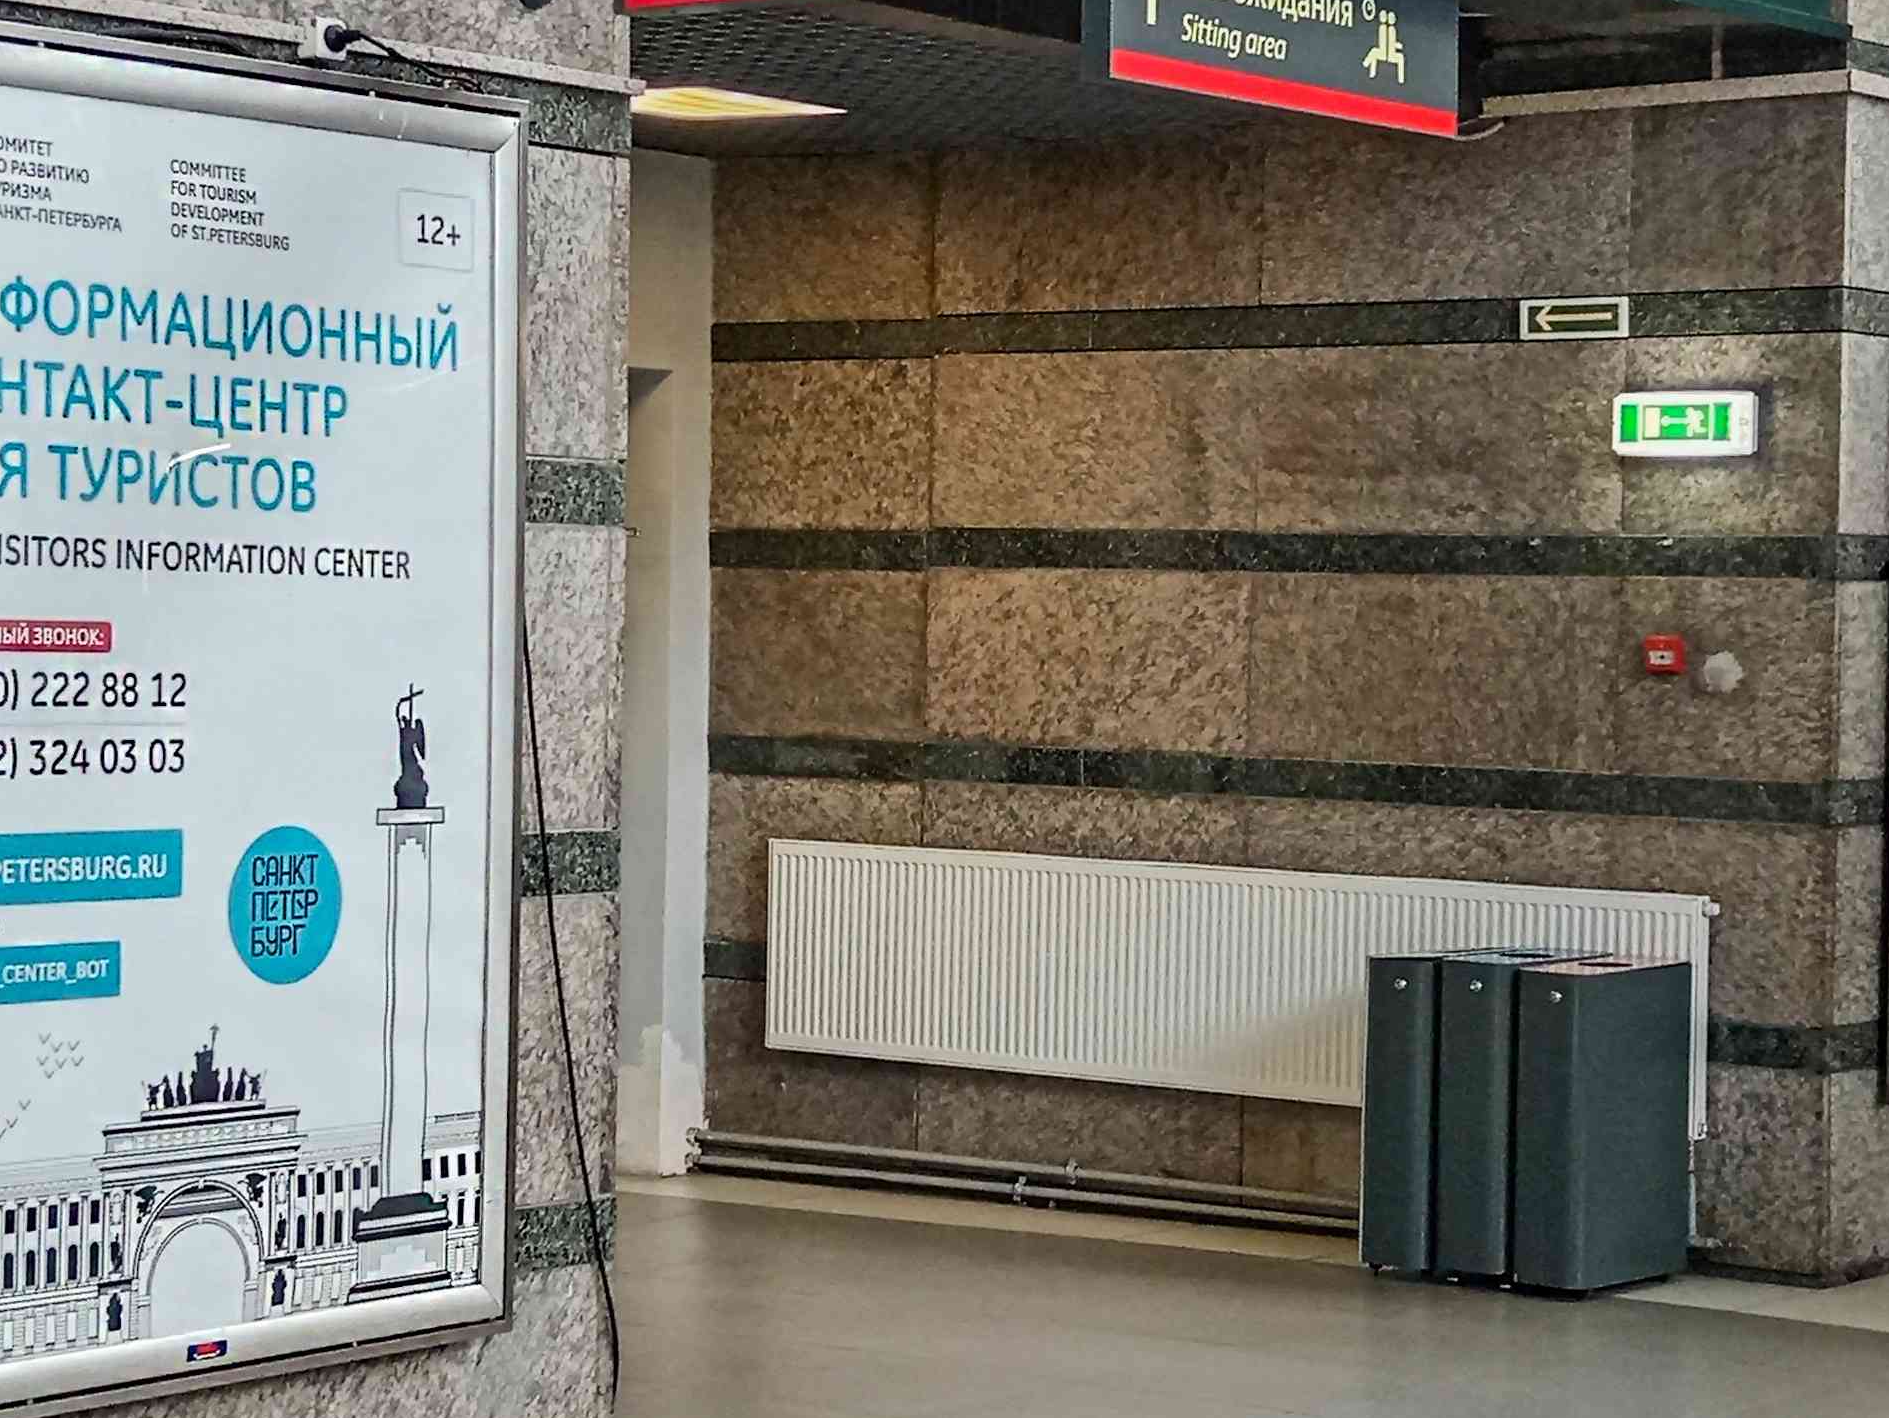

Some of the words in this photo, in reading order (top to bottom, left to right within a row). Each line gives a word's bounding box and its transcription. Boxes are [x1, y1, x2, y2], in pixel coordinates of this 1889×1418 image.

[1181, 12, 1243, 59] Sitting
[1244, 32, 1288, 61] area
[10, 159, 90, 184] РАЗВИТИЮ
[169, 159, 247, 183] COMMITTEE
[170, 181, 197, 199] FOR
[198, 184, 258, 205] TOURISM
[170, 202, 265, 228] DEVELOPMENT
[170, 224, 189, 240] OF
[415, 214, 462, 248] 12+
[47, 443, 317, 514] ТУРИСТОВ
[116, 538, 306, 577] INFORMATION
[314, 545, 411, 580] CENTER
[32, 627, 106, 646] ЗВОНОК:
[31, 671, 90, 708] 222
[101, 671, 139, 708] 88
[151, 672, 187, 707] 12
[28, 739, 90, 776] 324
[100, 739, 138, 774] 03
[148, 738, 185, 773] 03
[251, 854, 319, 887] САНКТ
[251, 888, 319, 923] ПЕТЕР
[251, 924, 307, 958] БУРГ
